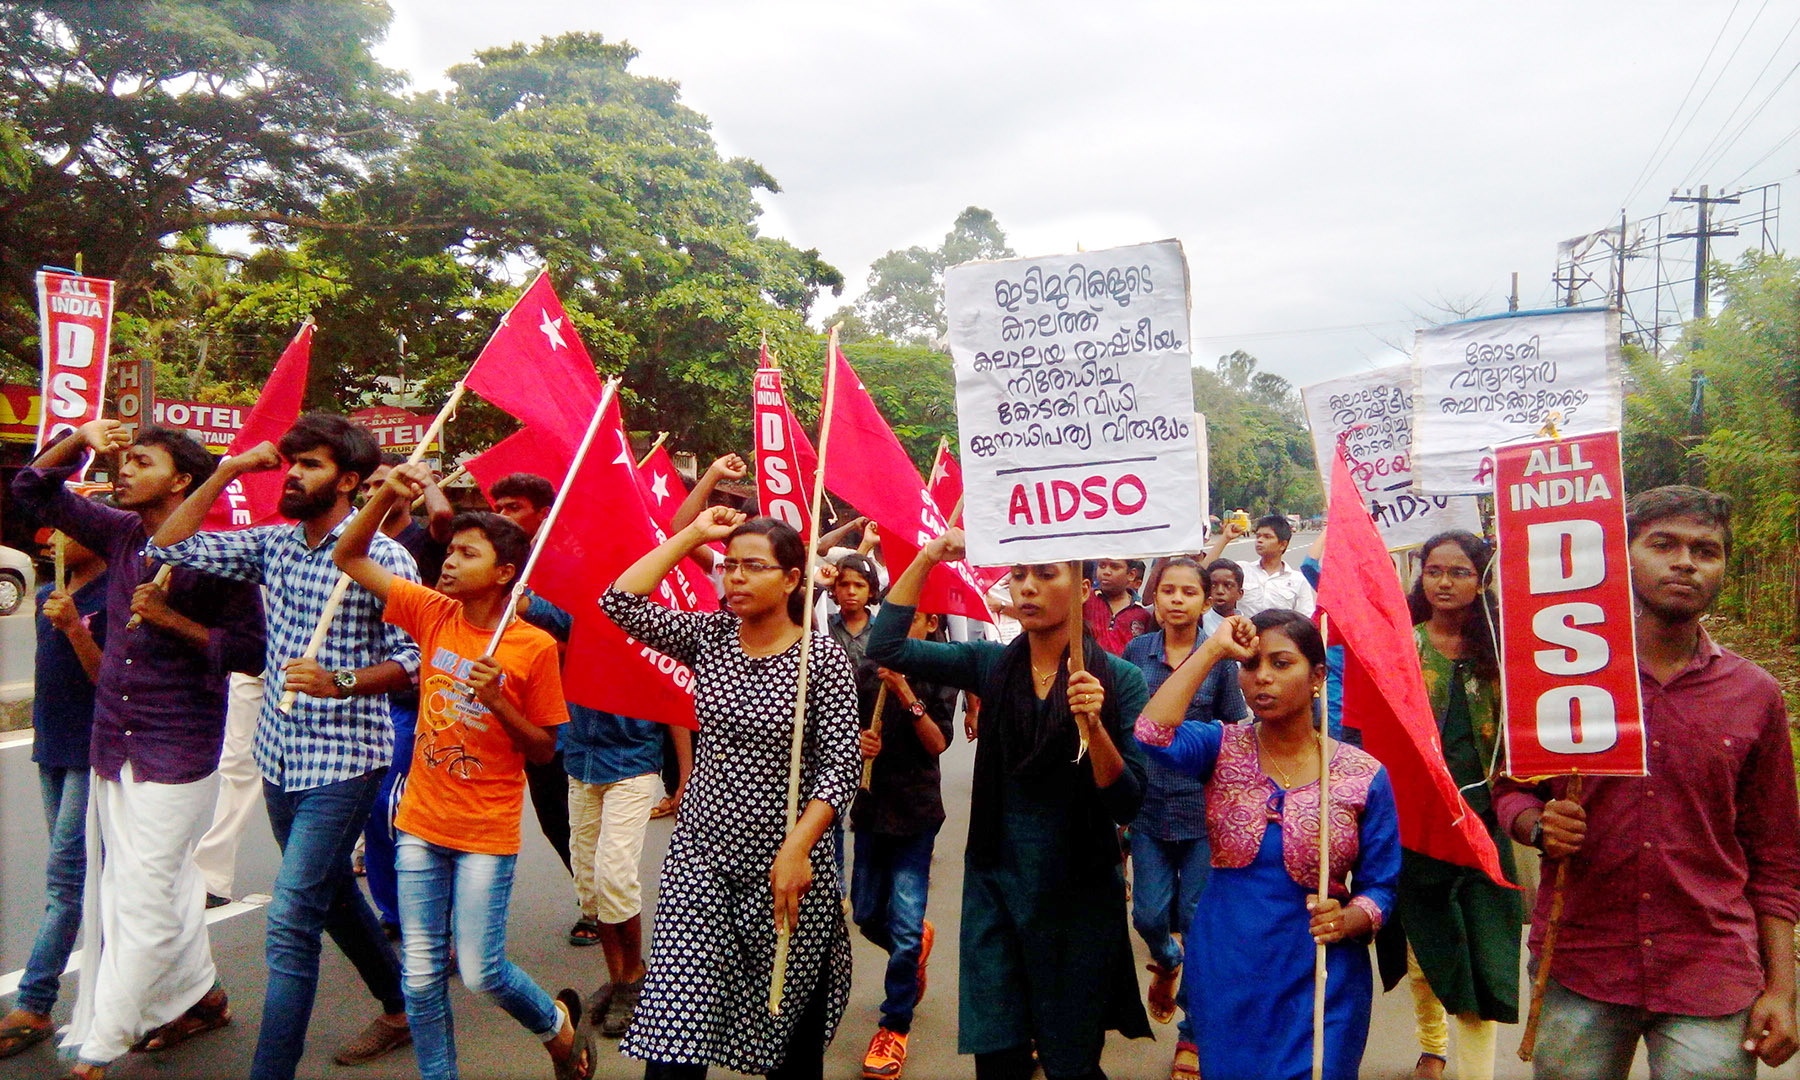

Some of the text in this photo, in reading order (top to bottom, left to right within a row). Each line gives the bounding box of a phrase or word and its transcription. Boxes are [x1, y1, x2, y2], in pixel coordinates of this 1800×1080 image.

[61, 279, 97, 298] ALL
[995, 263, 1154, 312] ഇടിമുറികളുടെ
[51, 296, 103, 318] INDIA
[1002, 305, 1104, 342] കാലത്ത്
[973, 344, 1066, 373] കലാലയ
[1465, 335, 1541, 366] കോടതി
[759, 374, 776, 390] ALL
[757, 390, 783, 407] INDIA
[997, 382, 1138, 425] കോടതി വിധി
[154, 402, 244, 429] HOTEL
[970, 423, 1092, 457] ജനാധിപത്യ
[1523, 443, 1593, 477] ALL
[1007, 473, 1148, 526] AIDSO
[1510, 473, 1612, 512] INDIA
